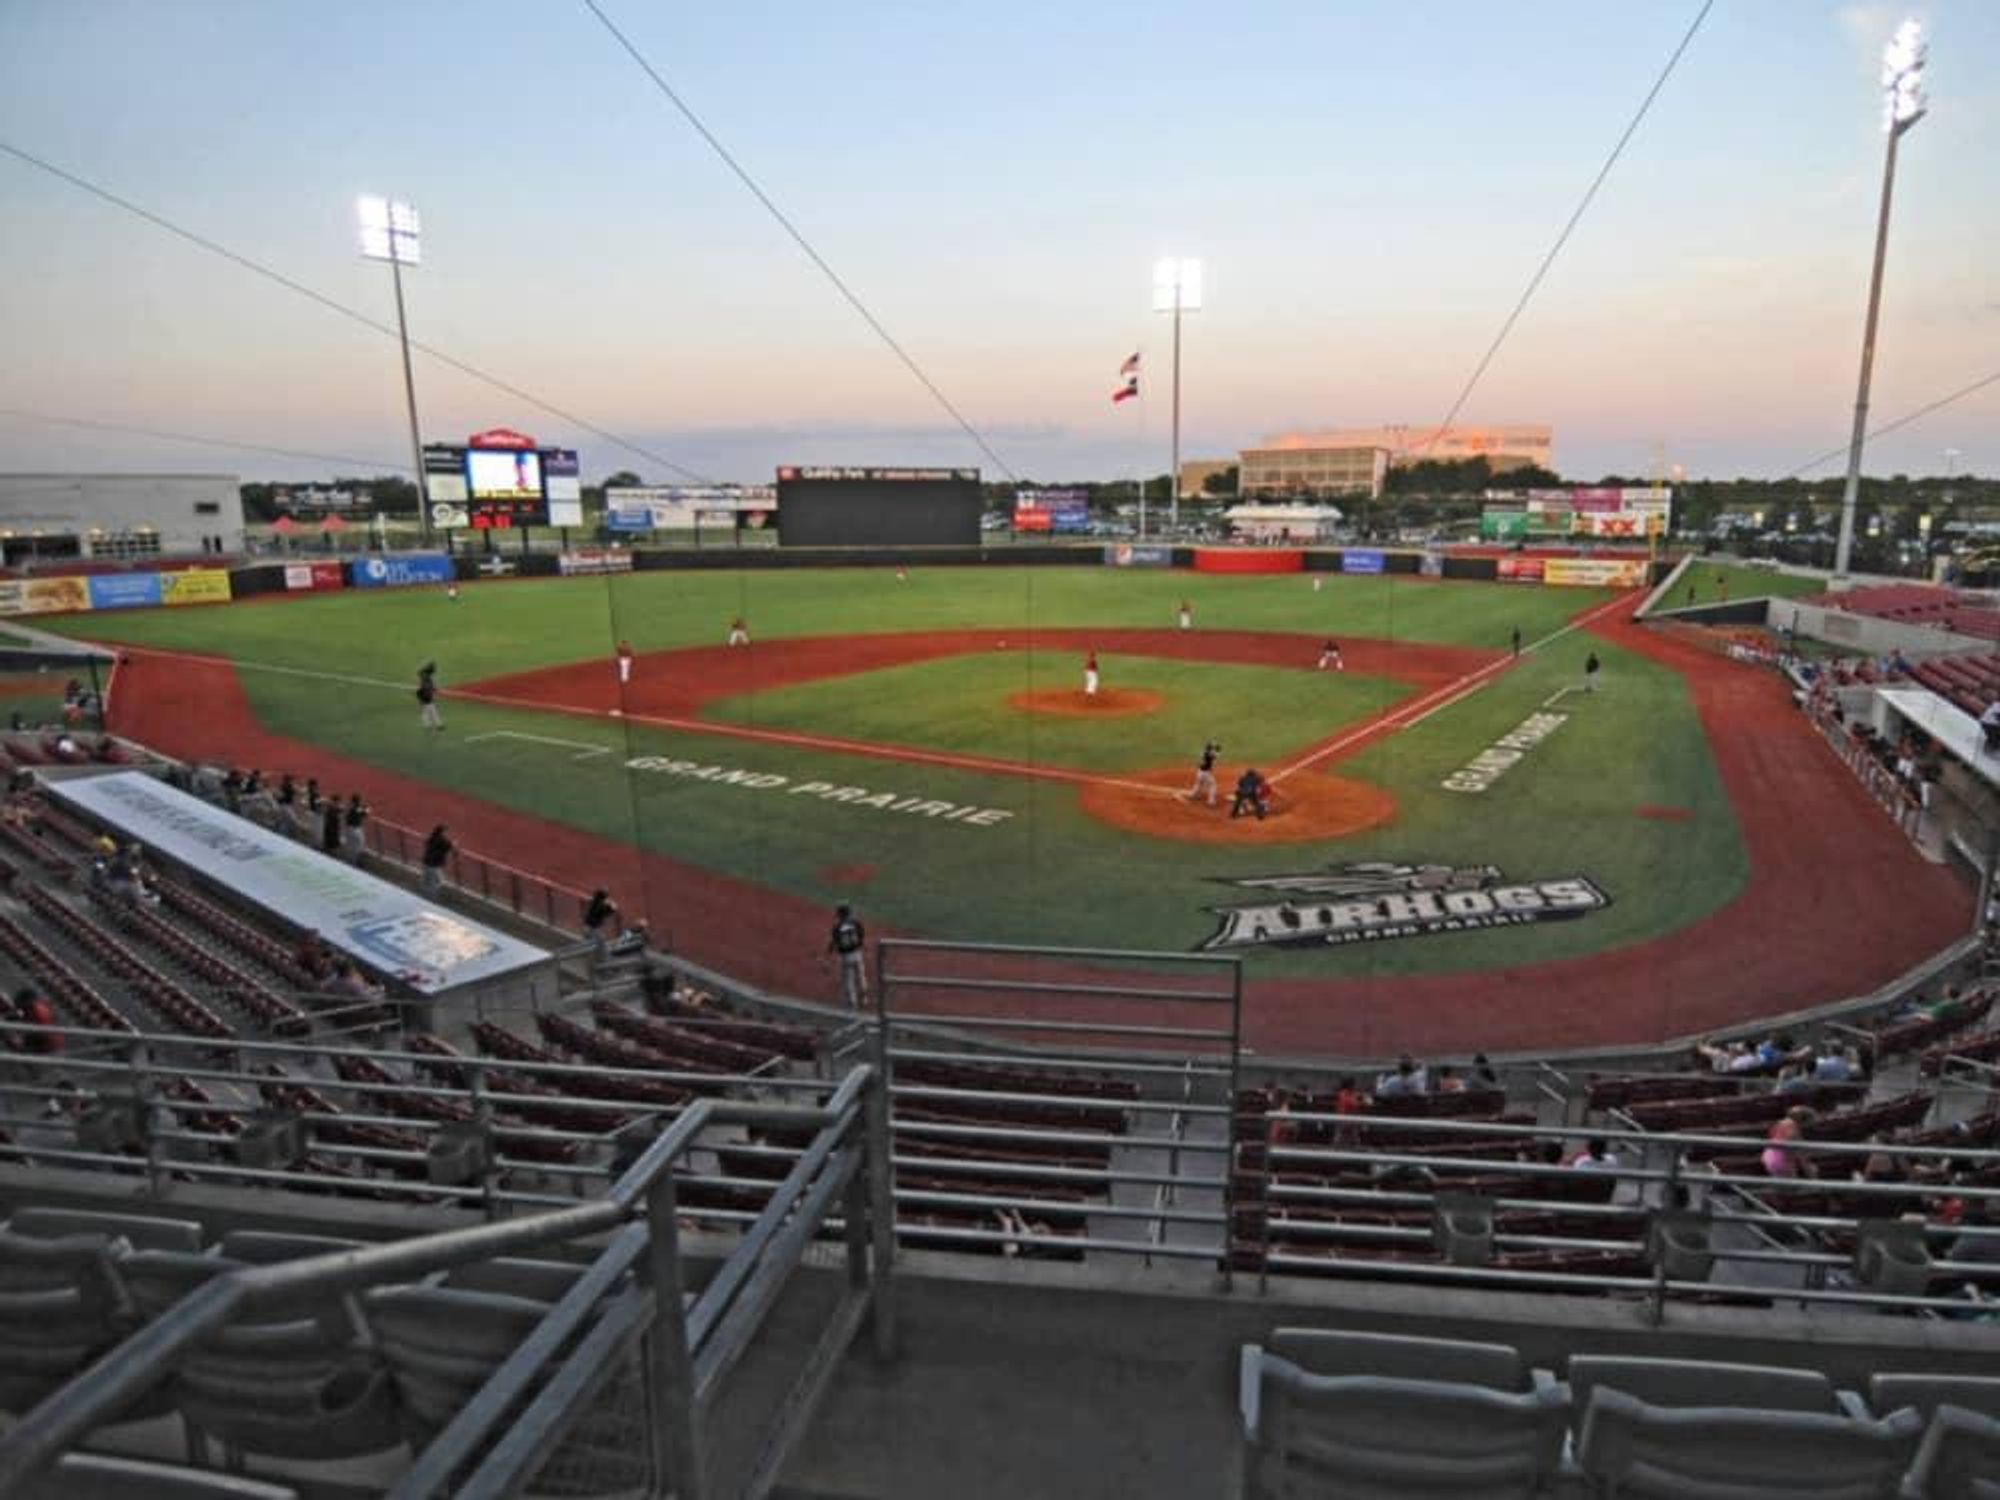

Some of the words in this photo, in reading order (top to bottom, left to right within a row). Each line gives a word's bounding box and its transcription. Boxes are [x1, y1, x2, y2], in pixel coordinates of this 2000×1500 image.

[624, 756, 789, 789] GRAND
[788, 780, 1015, 826] PRAIRIE
[1326, 925, 1419, 943] GRAND
[1428, 912, 1537, 933] PRAIRIE
